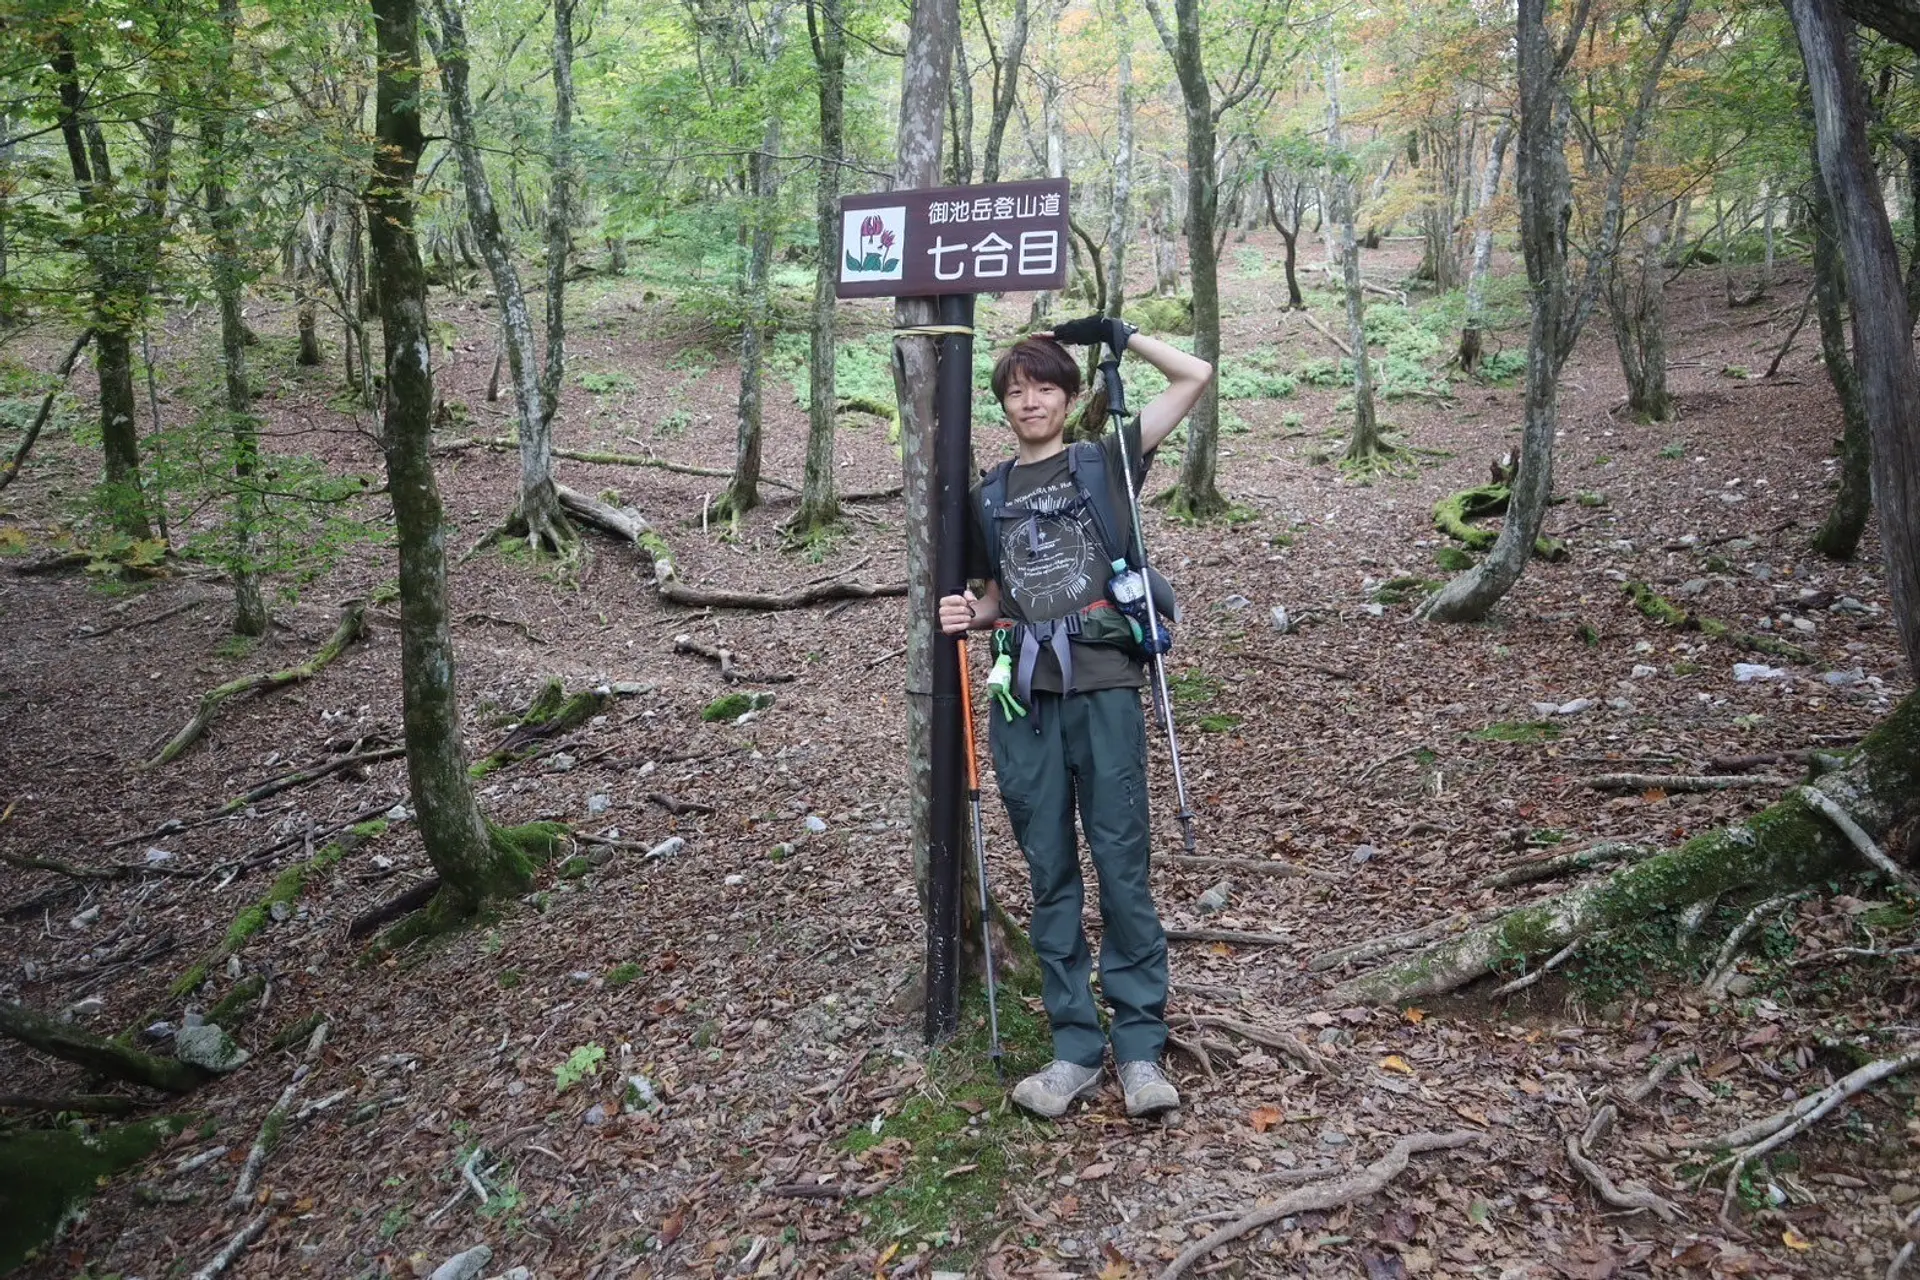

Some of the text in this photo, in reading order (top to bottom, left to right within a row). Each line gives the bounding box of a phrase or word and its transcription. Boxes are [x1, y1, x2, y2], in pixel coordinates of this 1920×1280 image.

[928, 193, 1061, 225] 御池岳登山道
[927, 230, 1059, 281] 七合目
